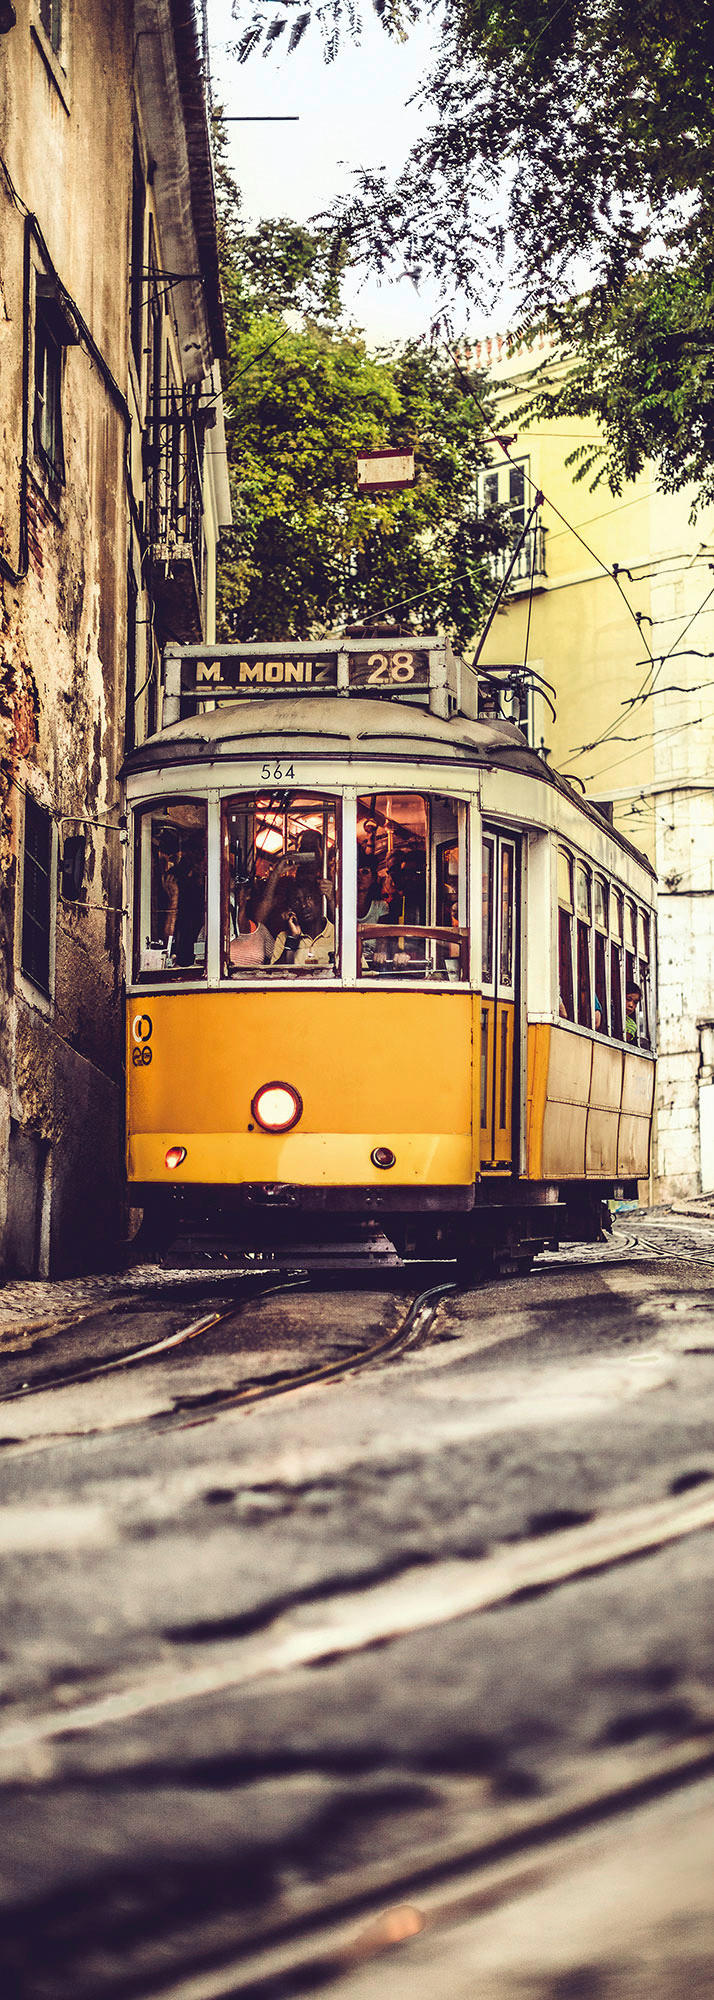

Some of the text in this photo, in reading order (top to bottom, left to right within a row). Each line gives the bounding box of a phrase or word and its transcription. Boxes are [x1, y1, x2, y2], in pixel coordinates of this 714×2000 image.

[196, 661, 336, 683] M. MONIZ
[367, 652, 415, 684] 28
[261, 764, 295, 780] 564
